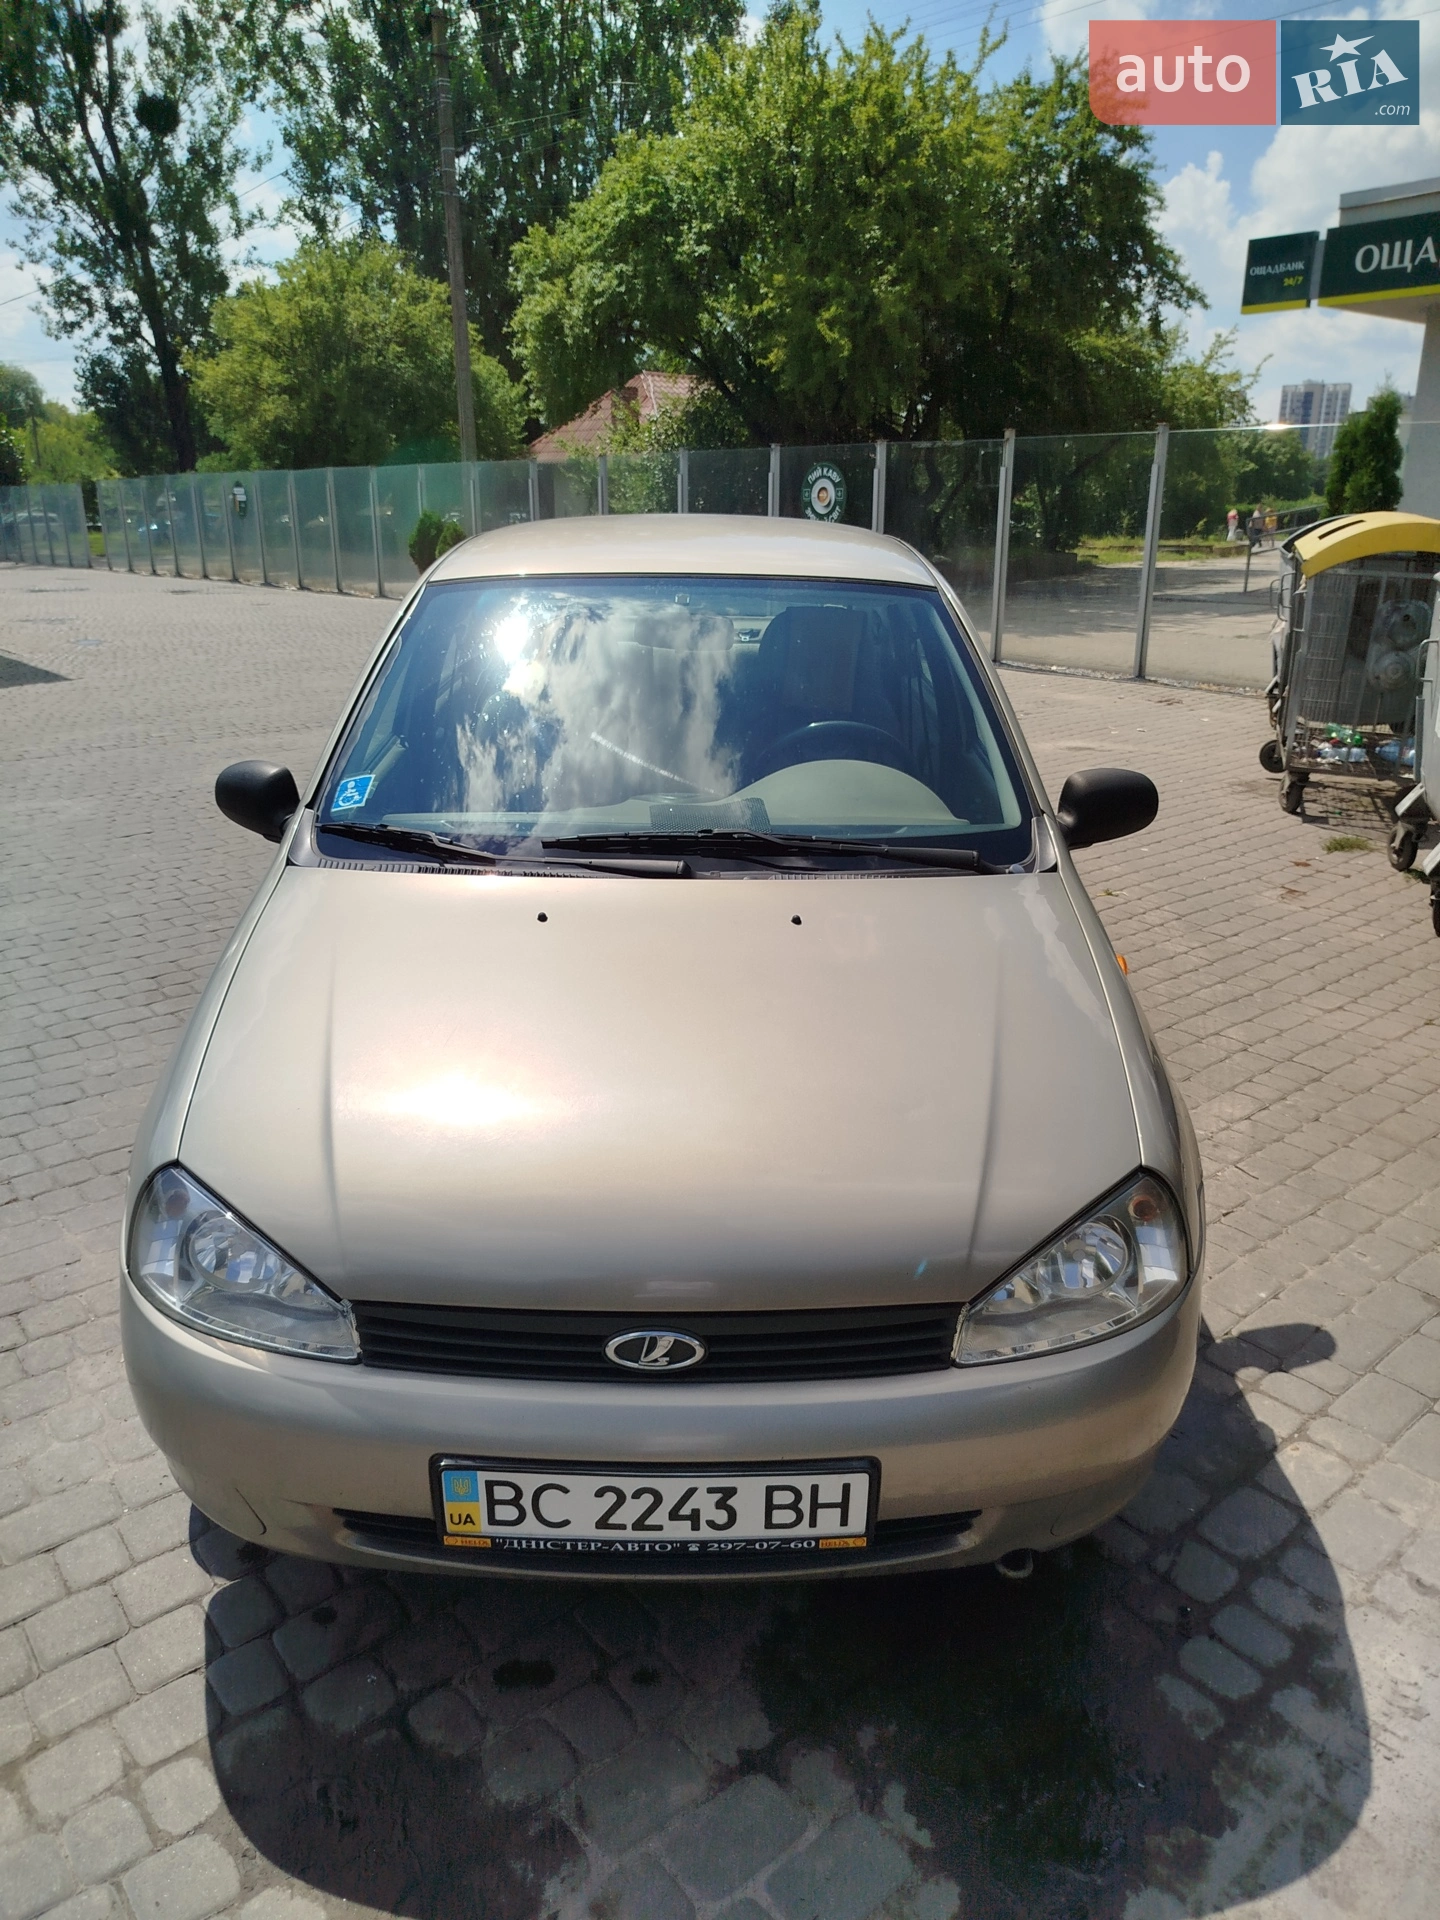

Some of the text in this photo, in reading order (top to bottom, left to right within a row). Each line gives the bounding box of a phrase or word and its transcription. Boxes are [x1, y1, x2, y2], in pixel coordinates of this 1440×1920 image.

[1249, 260, 1305, 276] ОЩАДБАНК
[823, 467, 841, 483] КАВУ
[484, 1479, 851, 1532] BC 2243 BH
[450, 1513, 476, 1526] UA
[707, 1539, 816, 1551] 297-07-60
